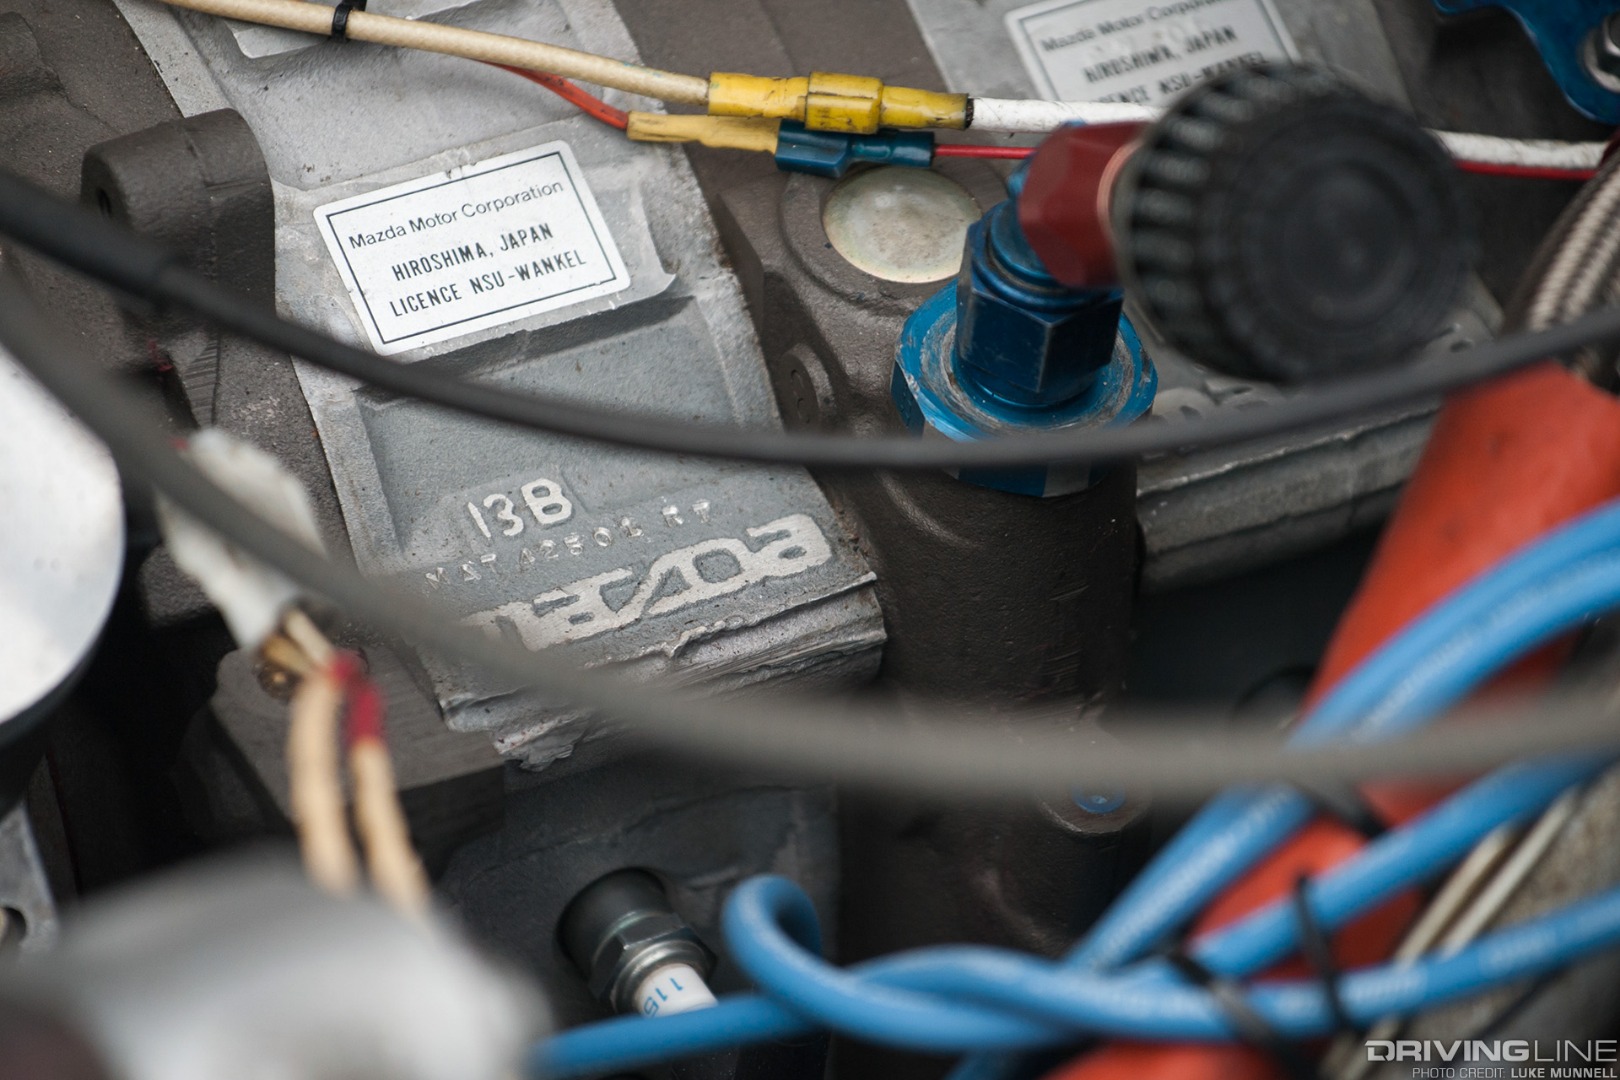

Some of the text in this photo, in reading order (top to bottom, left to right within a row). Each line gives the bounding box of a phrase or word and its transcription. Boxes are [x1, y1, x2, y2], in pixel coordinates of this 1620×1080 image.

[1185, 25, 1238, 53] JAPAN
[348, 181, 564, 249] Mazda Motor Corporation
[392, 222, 554, 282] HIROSHIMA, JAPAN
[389, 249, 587, 317] LICENCE NSU-WANKEL
[467, 478, 572, 539] 13B
